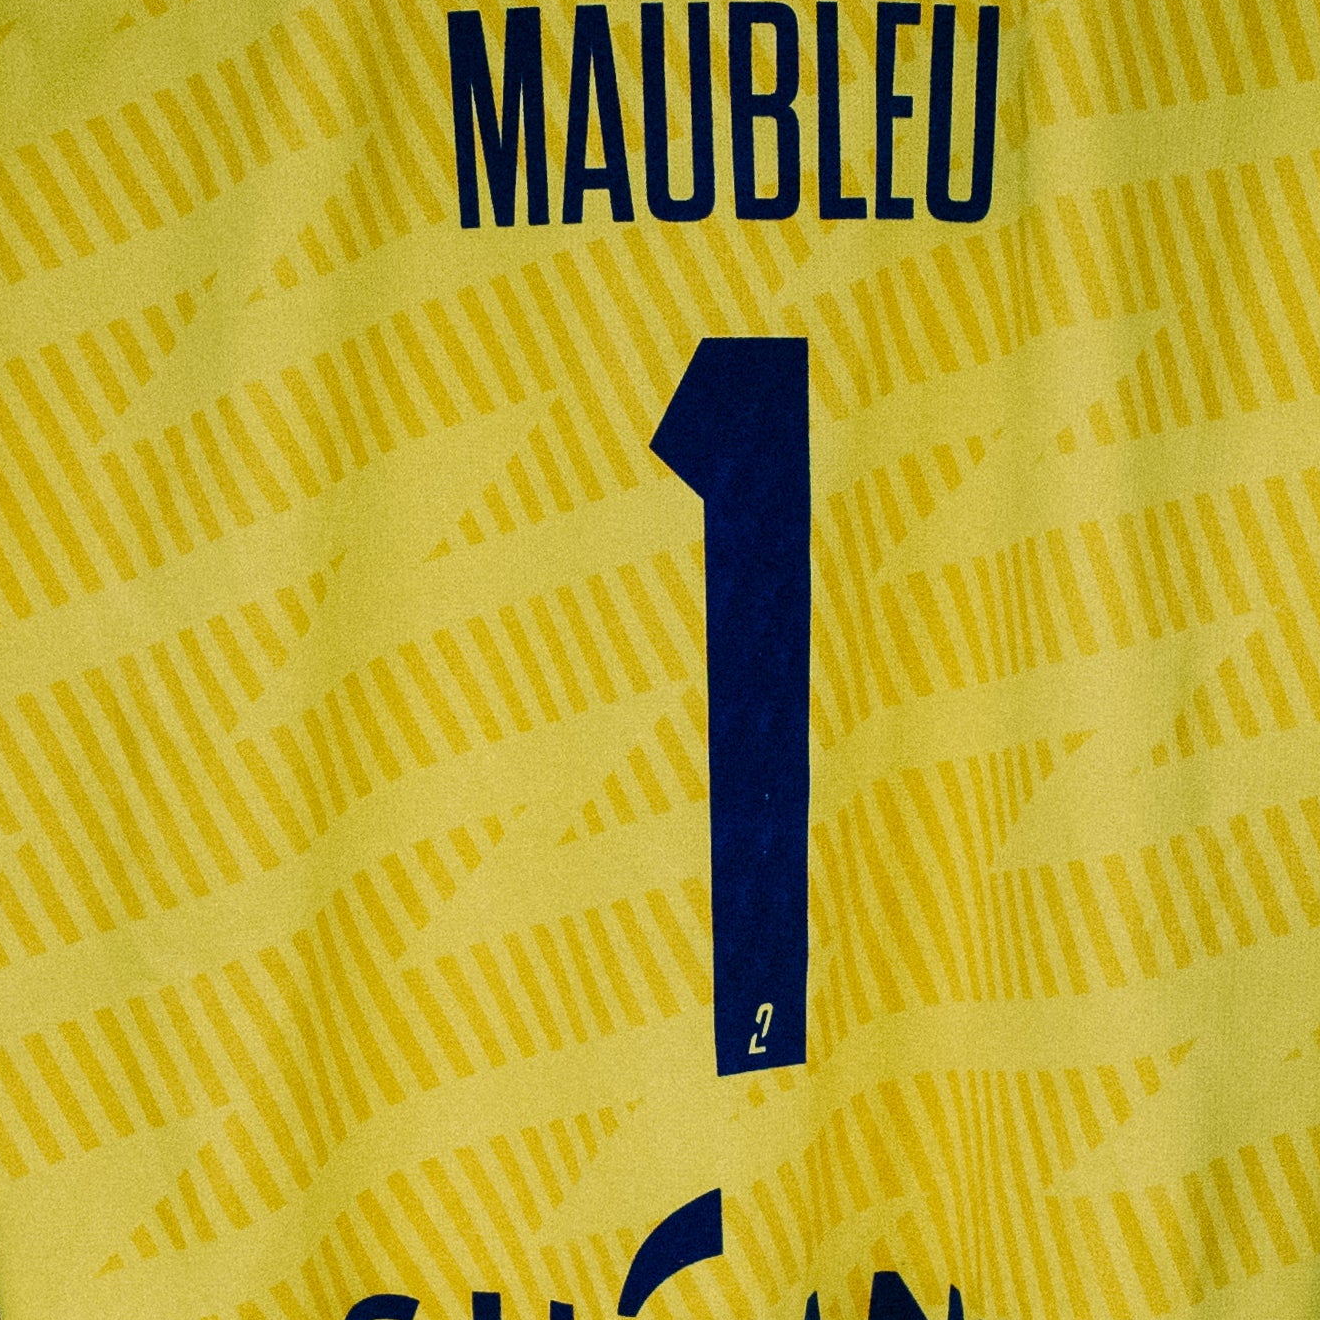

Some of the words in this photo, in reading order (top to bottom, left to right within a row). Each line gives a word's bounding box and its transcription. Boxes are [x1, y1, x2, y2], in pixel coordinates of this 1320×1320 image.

[447, 1, 1000, 229] MAUBLEU
[650, 337, 809, 1077] 1
[748, 1002, 774, 1055] 2
